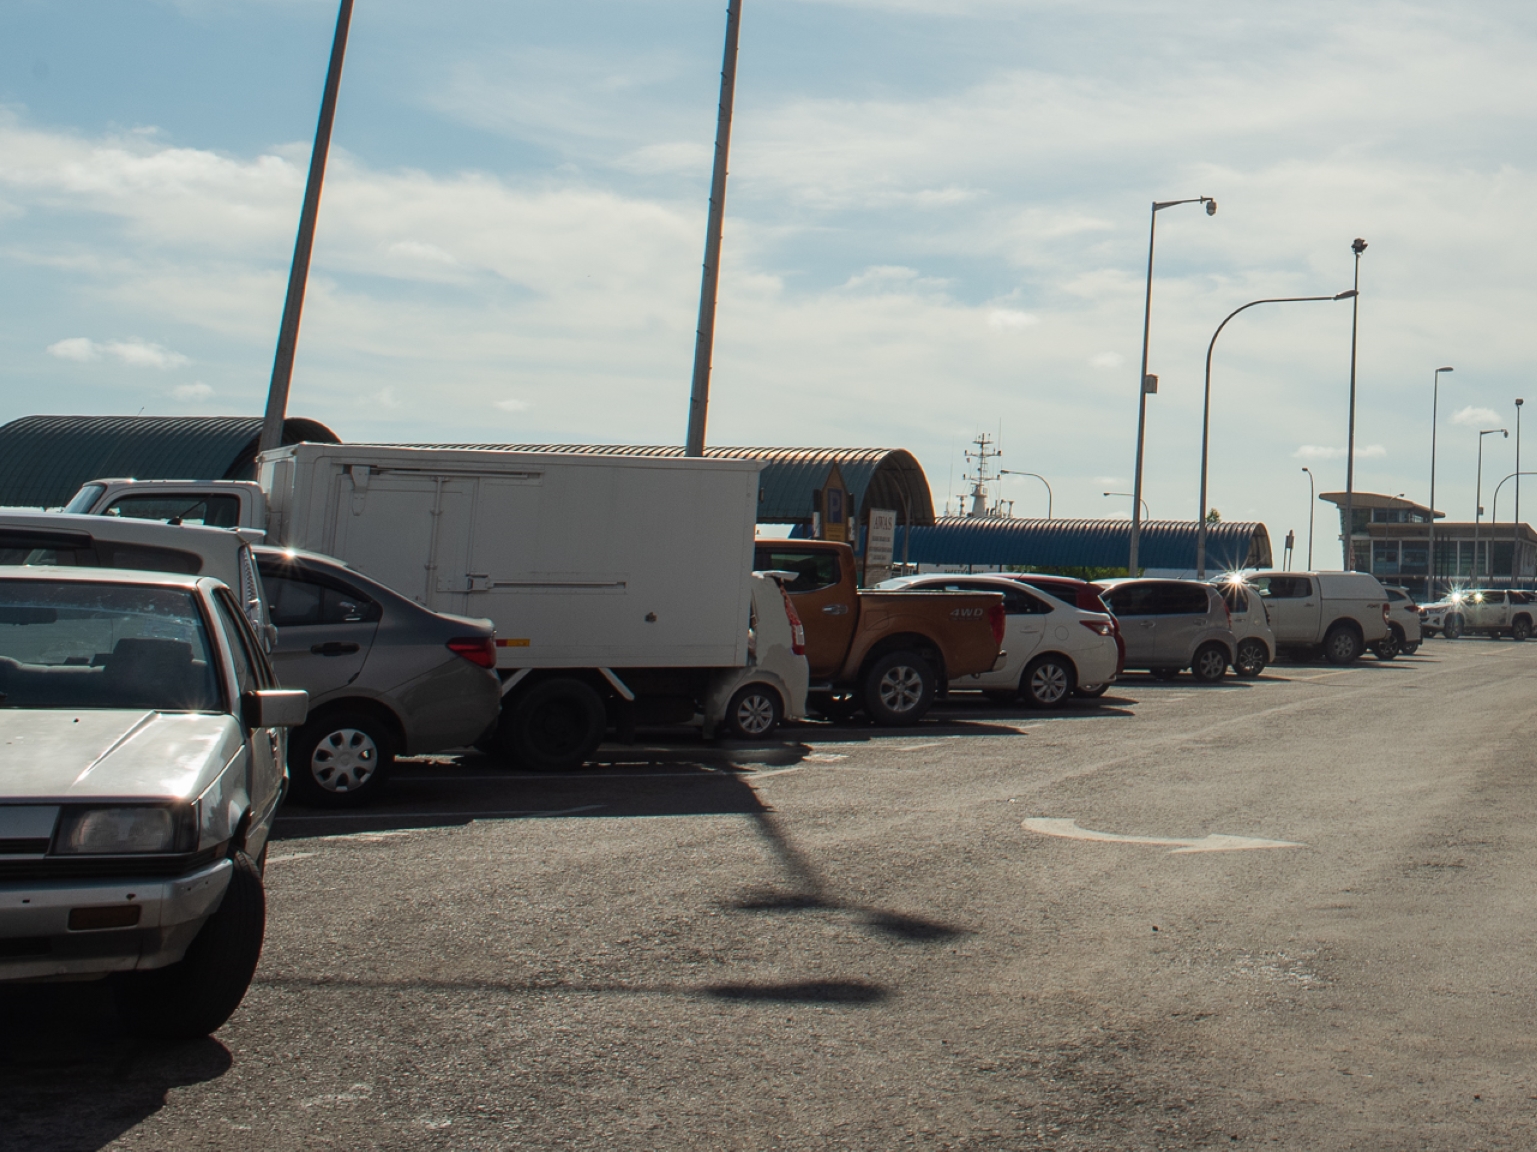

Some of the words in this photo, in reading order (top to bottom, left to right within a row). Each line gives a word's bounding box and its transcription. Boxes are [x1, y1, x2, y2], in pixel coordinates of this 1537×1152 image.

[829, 491, 841, 523] P
[873, 515, 893, 531] AWAS
[949, 607, 984, 617] 4WD
